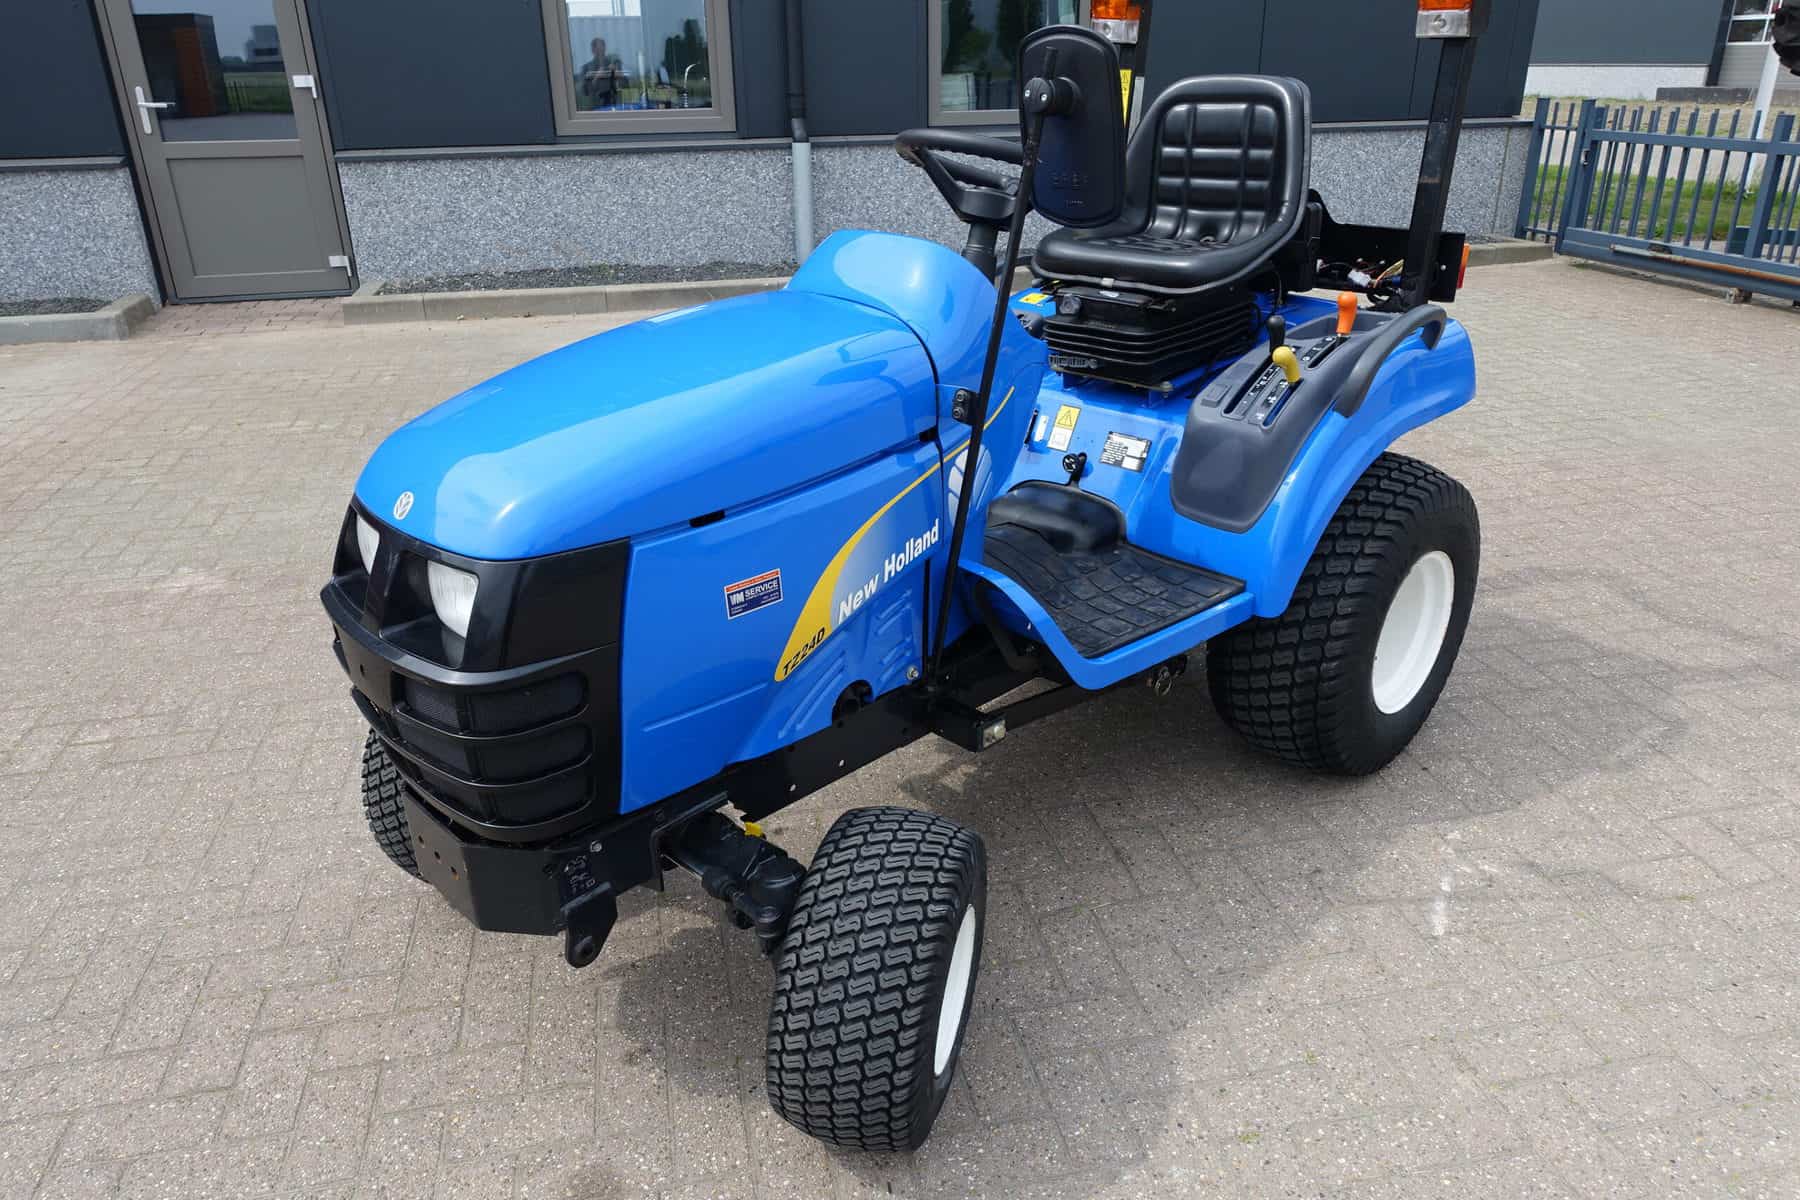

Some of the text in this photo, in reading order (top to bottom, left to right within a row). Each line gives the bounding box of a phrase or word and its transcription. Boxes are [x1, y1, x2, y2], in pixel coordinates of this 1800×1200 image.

[744, 578, 779, 597] SERVICE
[838, 518, 939, 625] New Holland
